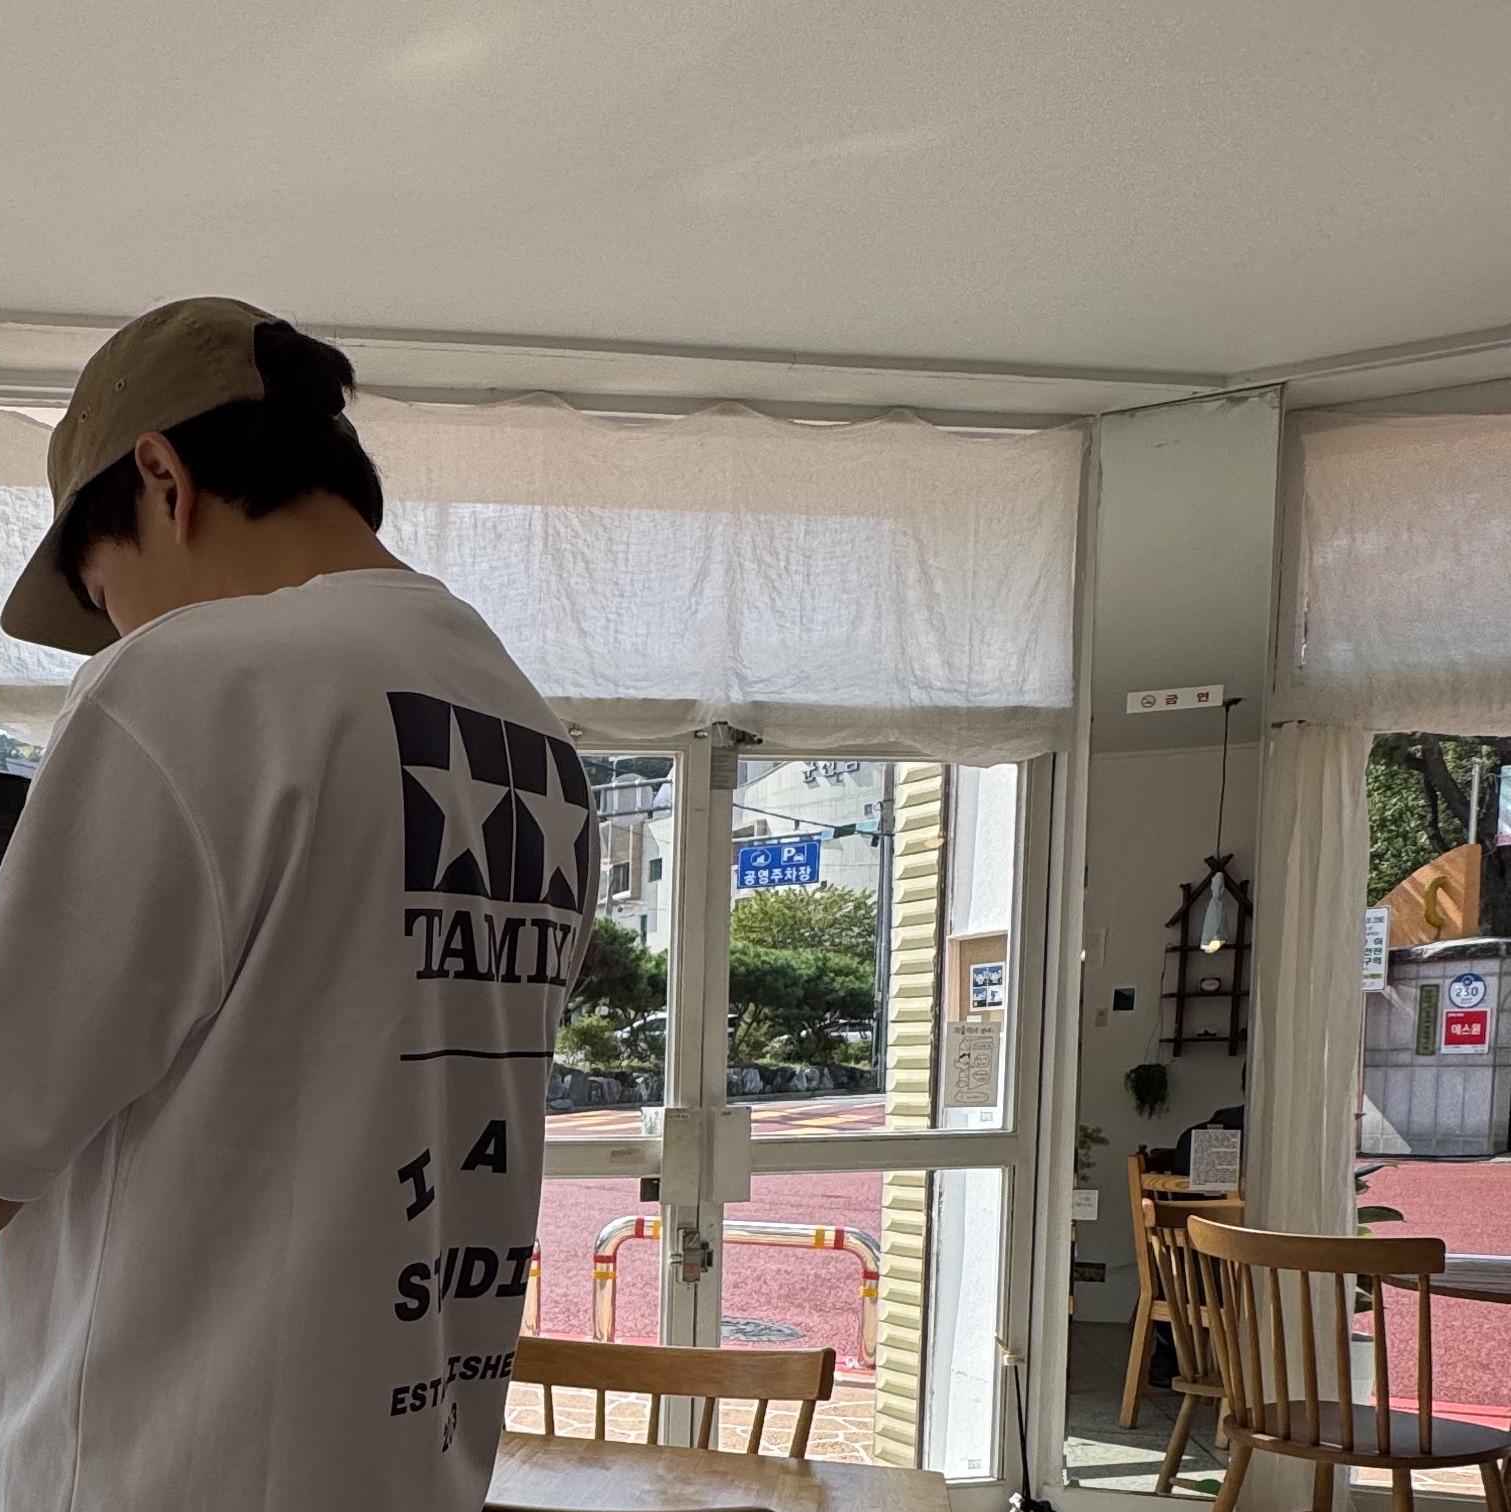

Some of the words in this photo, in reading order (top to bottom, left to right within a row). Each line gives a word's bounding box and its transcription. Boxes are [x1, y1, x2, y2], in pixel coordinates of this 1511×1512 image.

[783, 847, 796, 862] P
[743, 865, 811, 886] 공영주차장
[404, 907, 572, 987] TAMIY
[1456, 986, 1478, 997] 230
